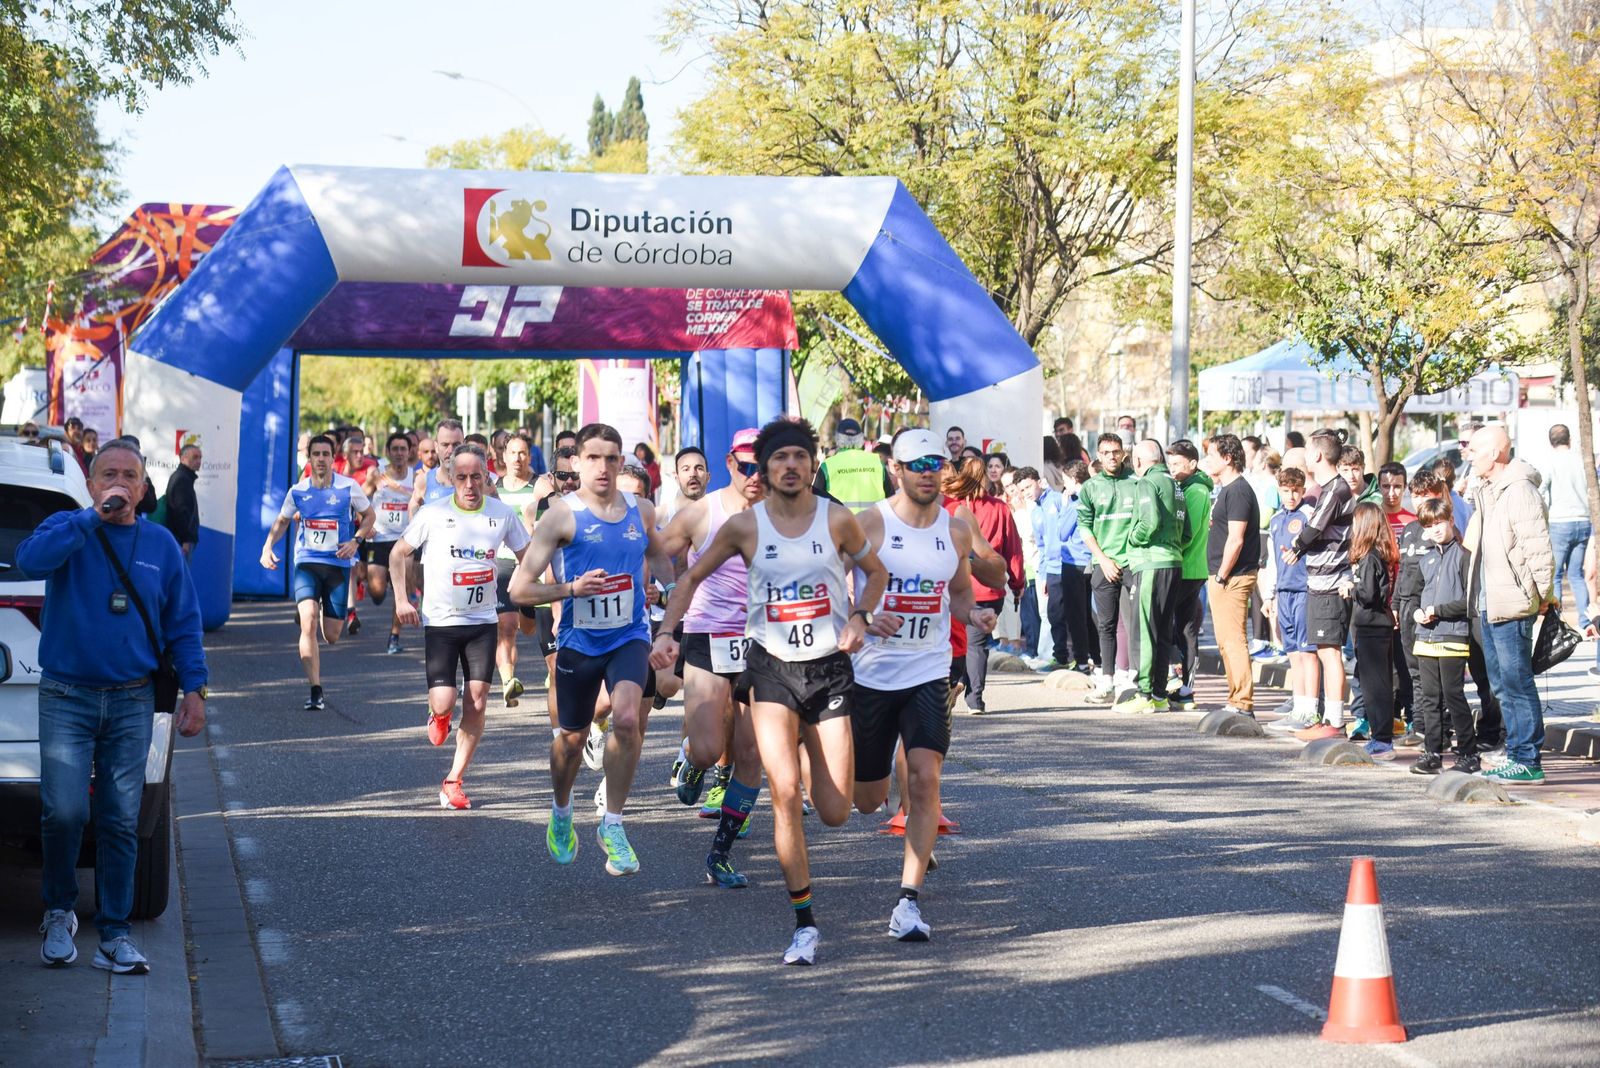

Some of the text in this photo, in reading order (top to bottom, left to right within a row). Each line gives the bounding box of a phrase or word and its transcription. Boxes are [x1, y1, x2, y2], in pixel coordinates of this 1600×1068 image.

[571, 208, 733, 238] Diputación
[568, 241, 733, 265] de Córdoba
[686, 288, 704, 299] DE
[686, 301, 703, 312] SE
[706, 300, 744, 311] TRATA
[837, 467, 875, 475] VOLUNTARIOS
[389, 511, 401, 523] 34
[313, 531, 327, 544] 27
[450, 545, 495, 560] indea
[767, 580, 828, 603] indea
[887, 572, 946, 594] indea
[466, 586, 484, 605] 76
[587, 595, 621, 618] 111
[788, 623, 814, 648] 48
[891, 615, 931, 639] 216
[729, 638, 749, 661] 52
